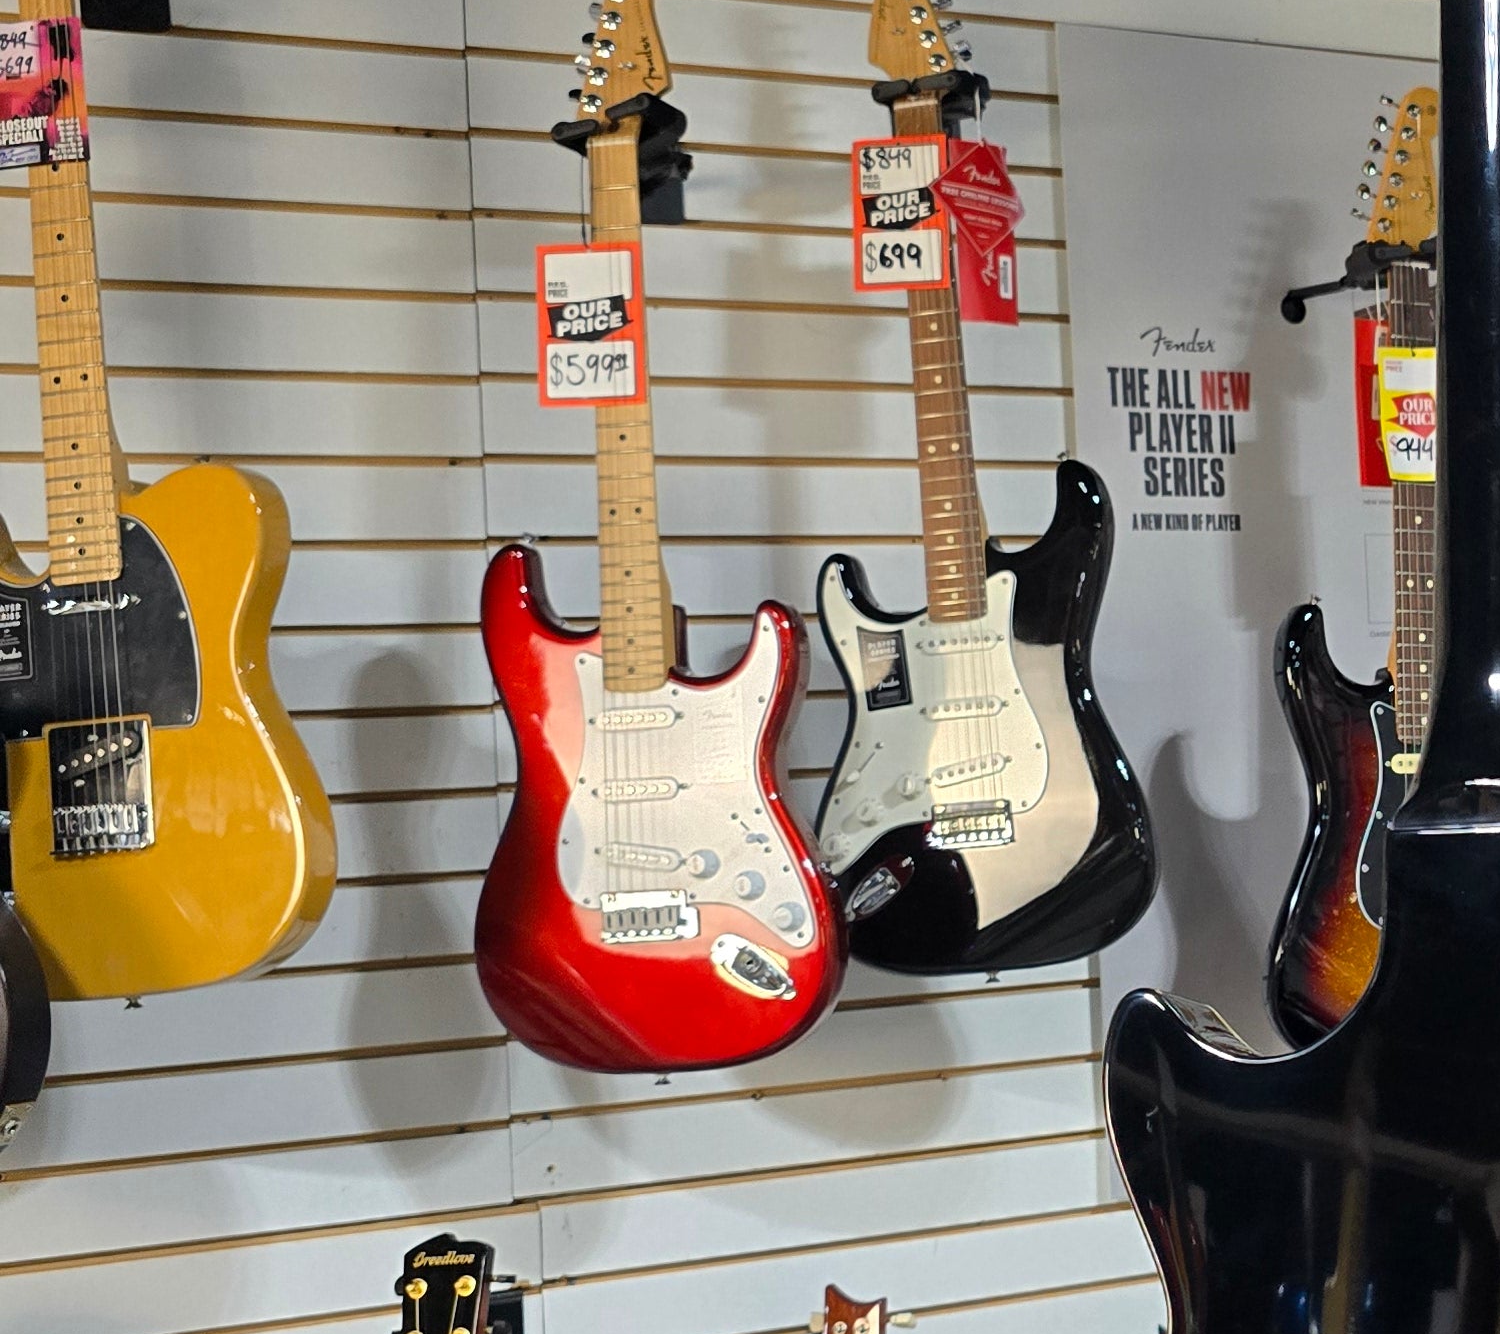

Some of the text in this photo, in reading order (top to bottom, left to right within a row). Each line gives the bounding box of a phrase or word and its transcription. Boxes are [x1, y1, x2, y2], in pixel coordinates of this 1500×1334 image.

[870, 202, 931, 227] PRICE
[876, 190, 920, 212] OUR
[865, 240, 922, 274] $699
[562, 299, 611, 320] OUR
[556, 311, 623, 338] PRICE
[1140, 326, 1217, 357] Fender
[1107, 367, 1251, 412] THE ALL NEW
[1128, 412, 1236, 455] PLAYER II
[1143, 456, 1226, 498] SERIES
[1132, 513, 1241, 531] A NEW KIND OF PLAYER
